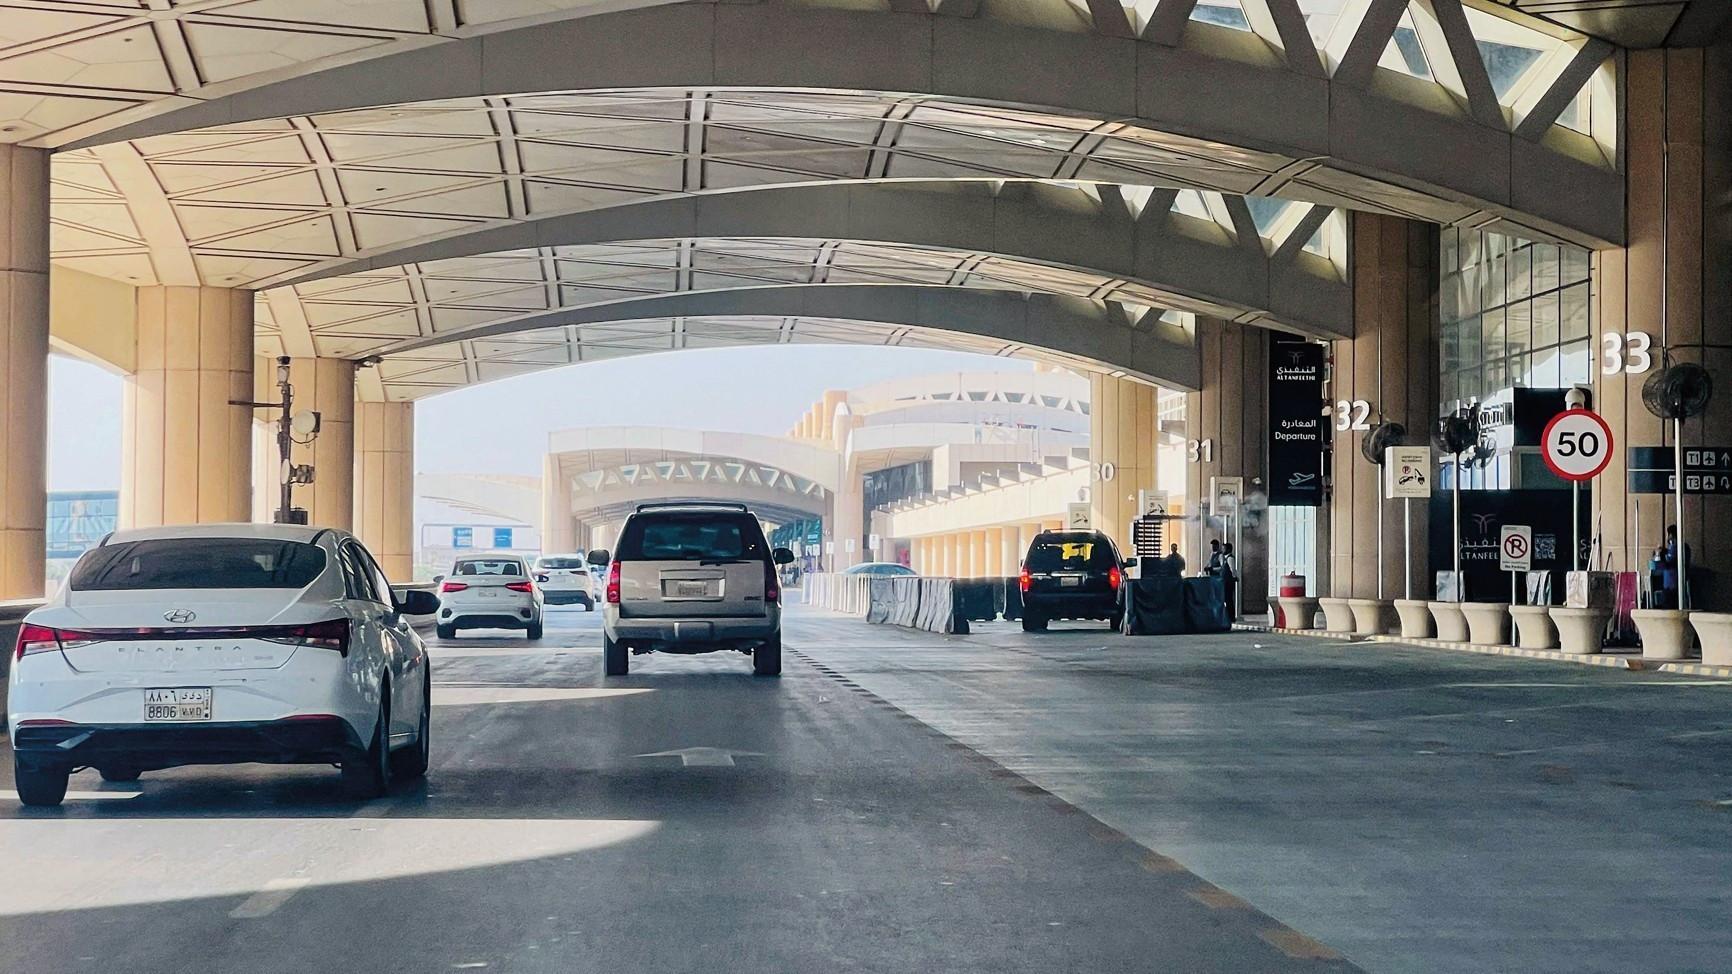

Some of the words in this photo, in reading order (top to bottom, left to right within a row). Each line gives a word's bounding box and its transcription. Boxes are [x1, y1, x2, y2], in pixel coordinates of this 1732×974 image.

[1602, 331, 1651, 375] 33
[1336, 399, 1371, 431] 32
[1274, 431, 1316, 442] Departure
[1557, 431, 1600, 457] 50
[1187, 439, 1212, 463] 31
[1687, 452, 1699, 465] T1
[1092, 462, 1115, 482] 30
[1687, 477, 1699, 489] T3
[148, 706, 177, 719] 8806
